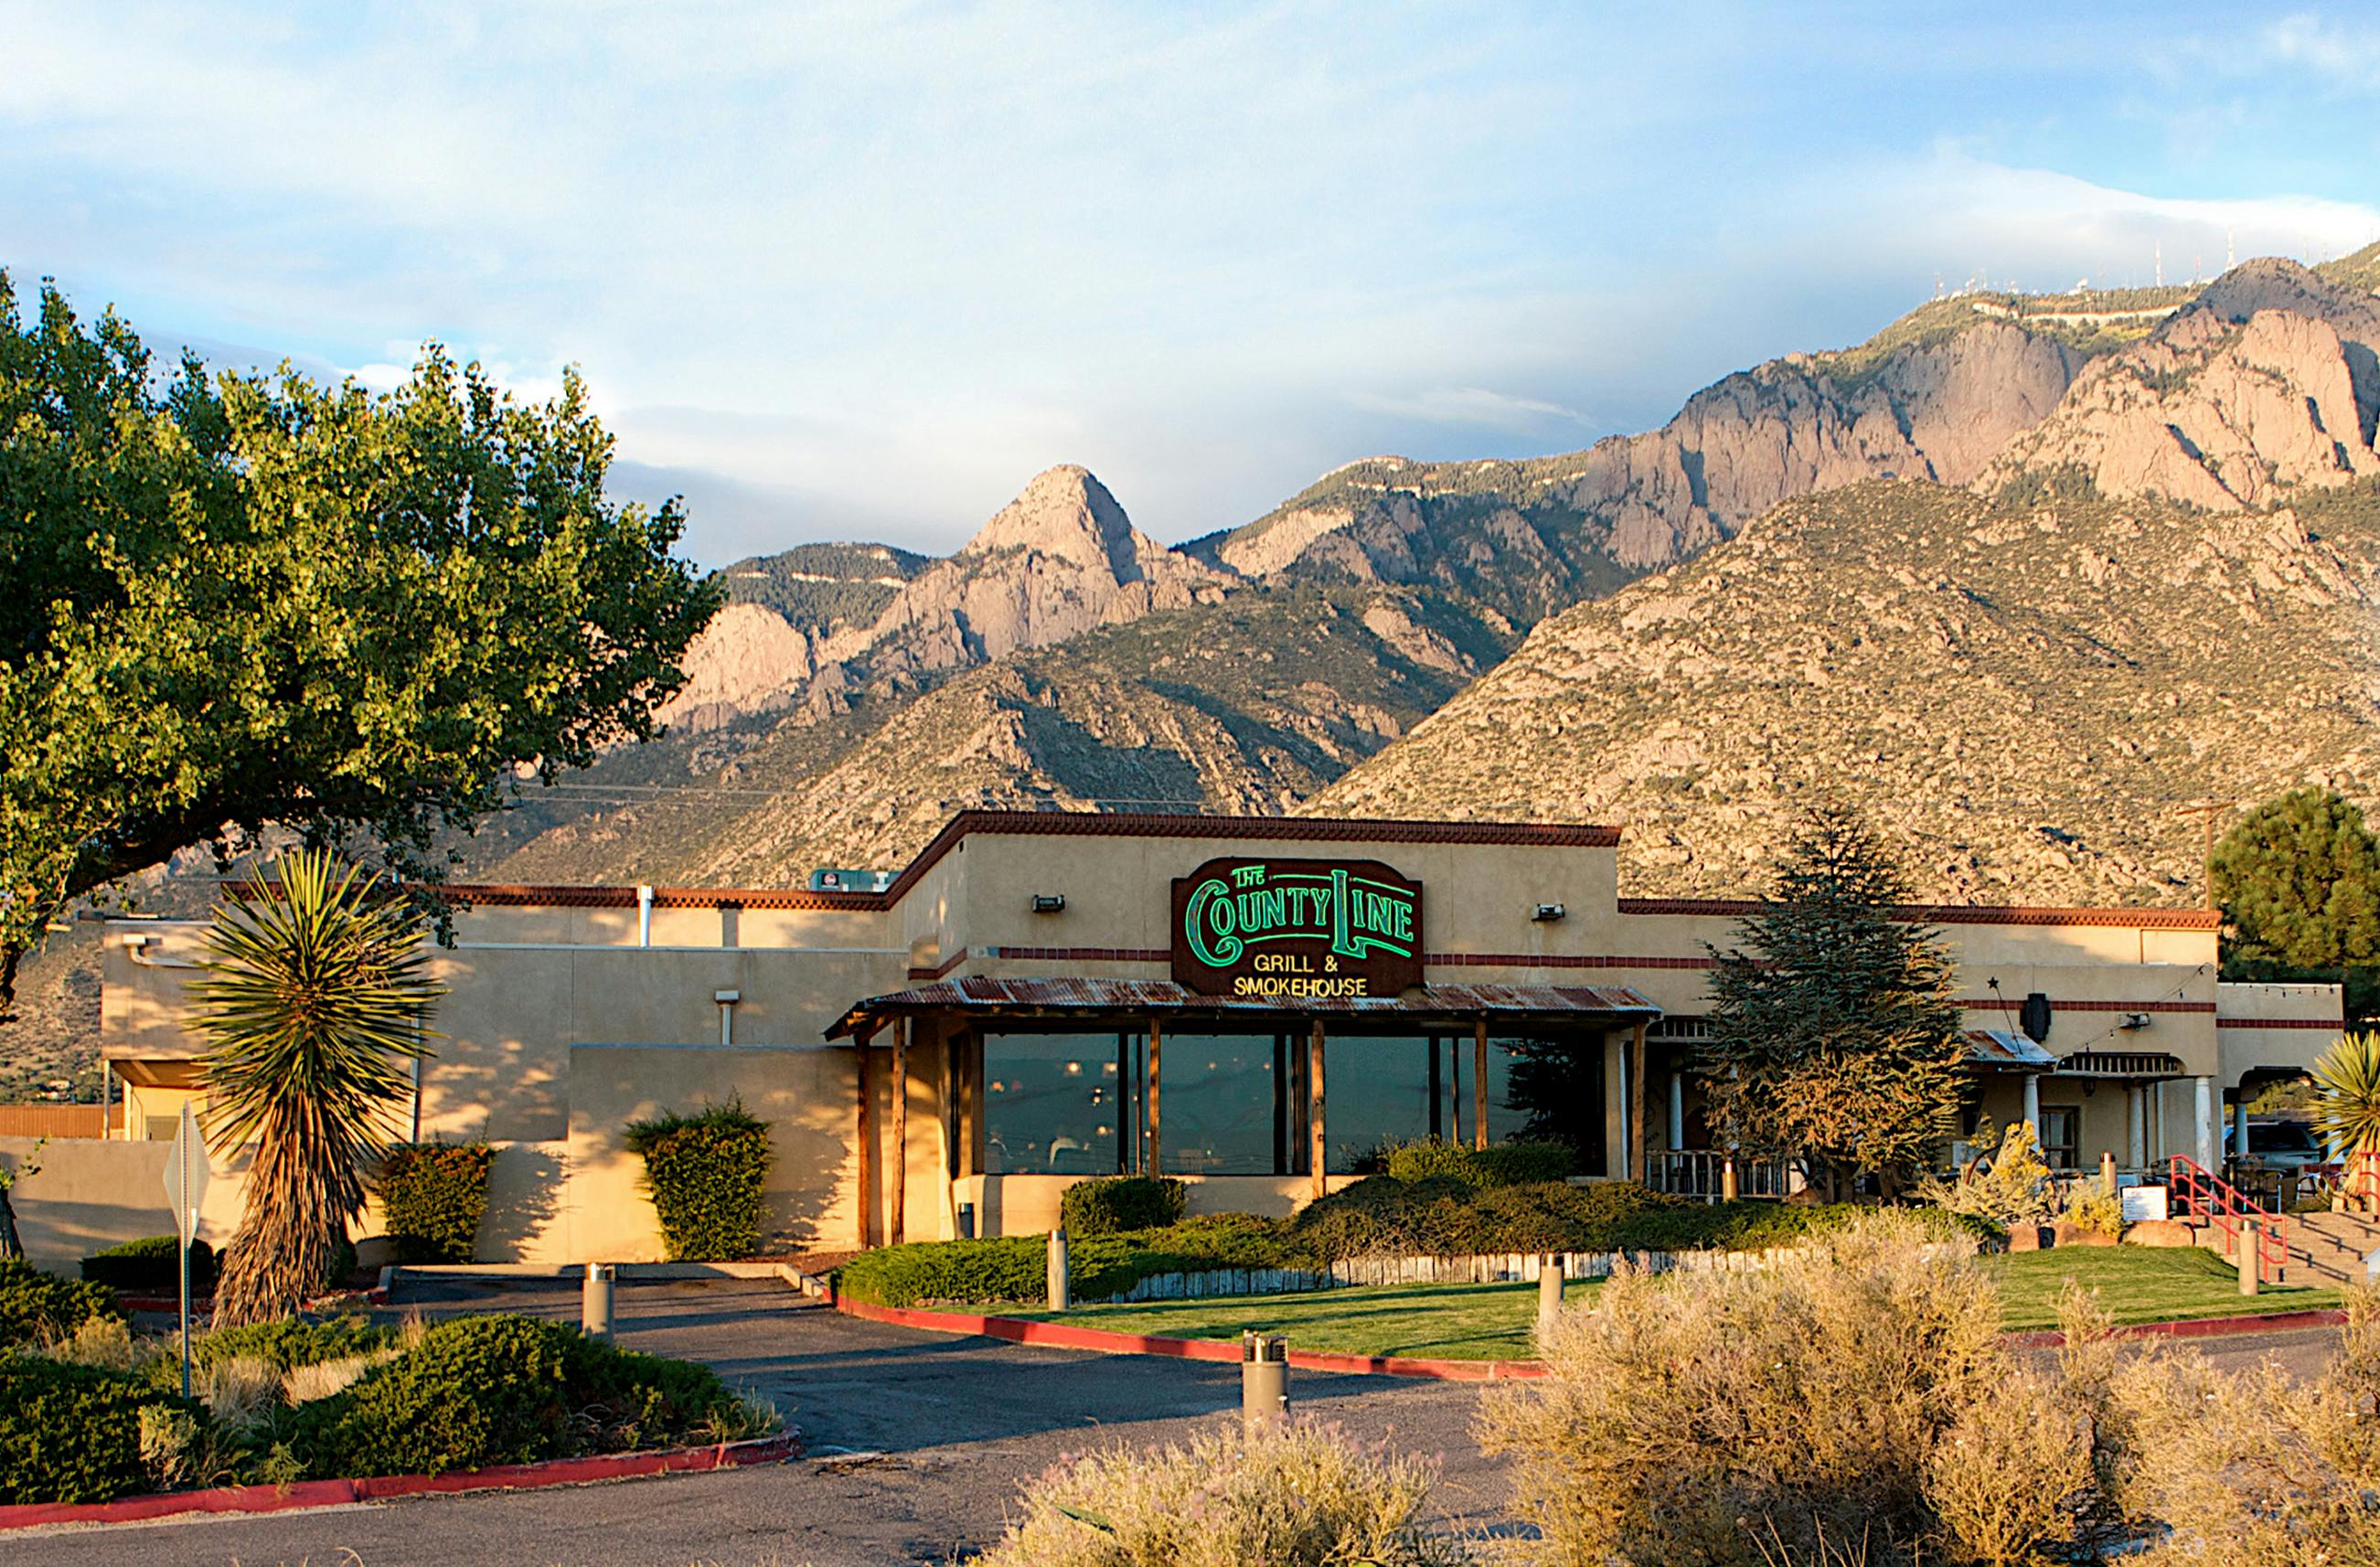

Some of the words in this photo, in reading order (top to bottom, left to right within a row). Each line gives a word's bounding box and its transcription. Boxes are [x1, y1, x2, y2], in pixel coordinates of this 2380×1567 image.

[1232, 865, 1265, 888] THE
[1186, 879, 1330, 967] COUNTY
[1331, 869, 1414, 959] LINE
[1254, 954, 1315, 973] GRILL
[1324, 954, 1338, 973] &
[1233, 976, 1368, 997] SMOKEHOUSE
